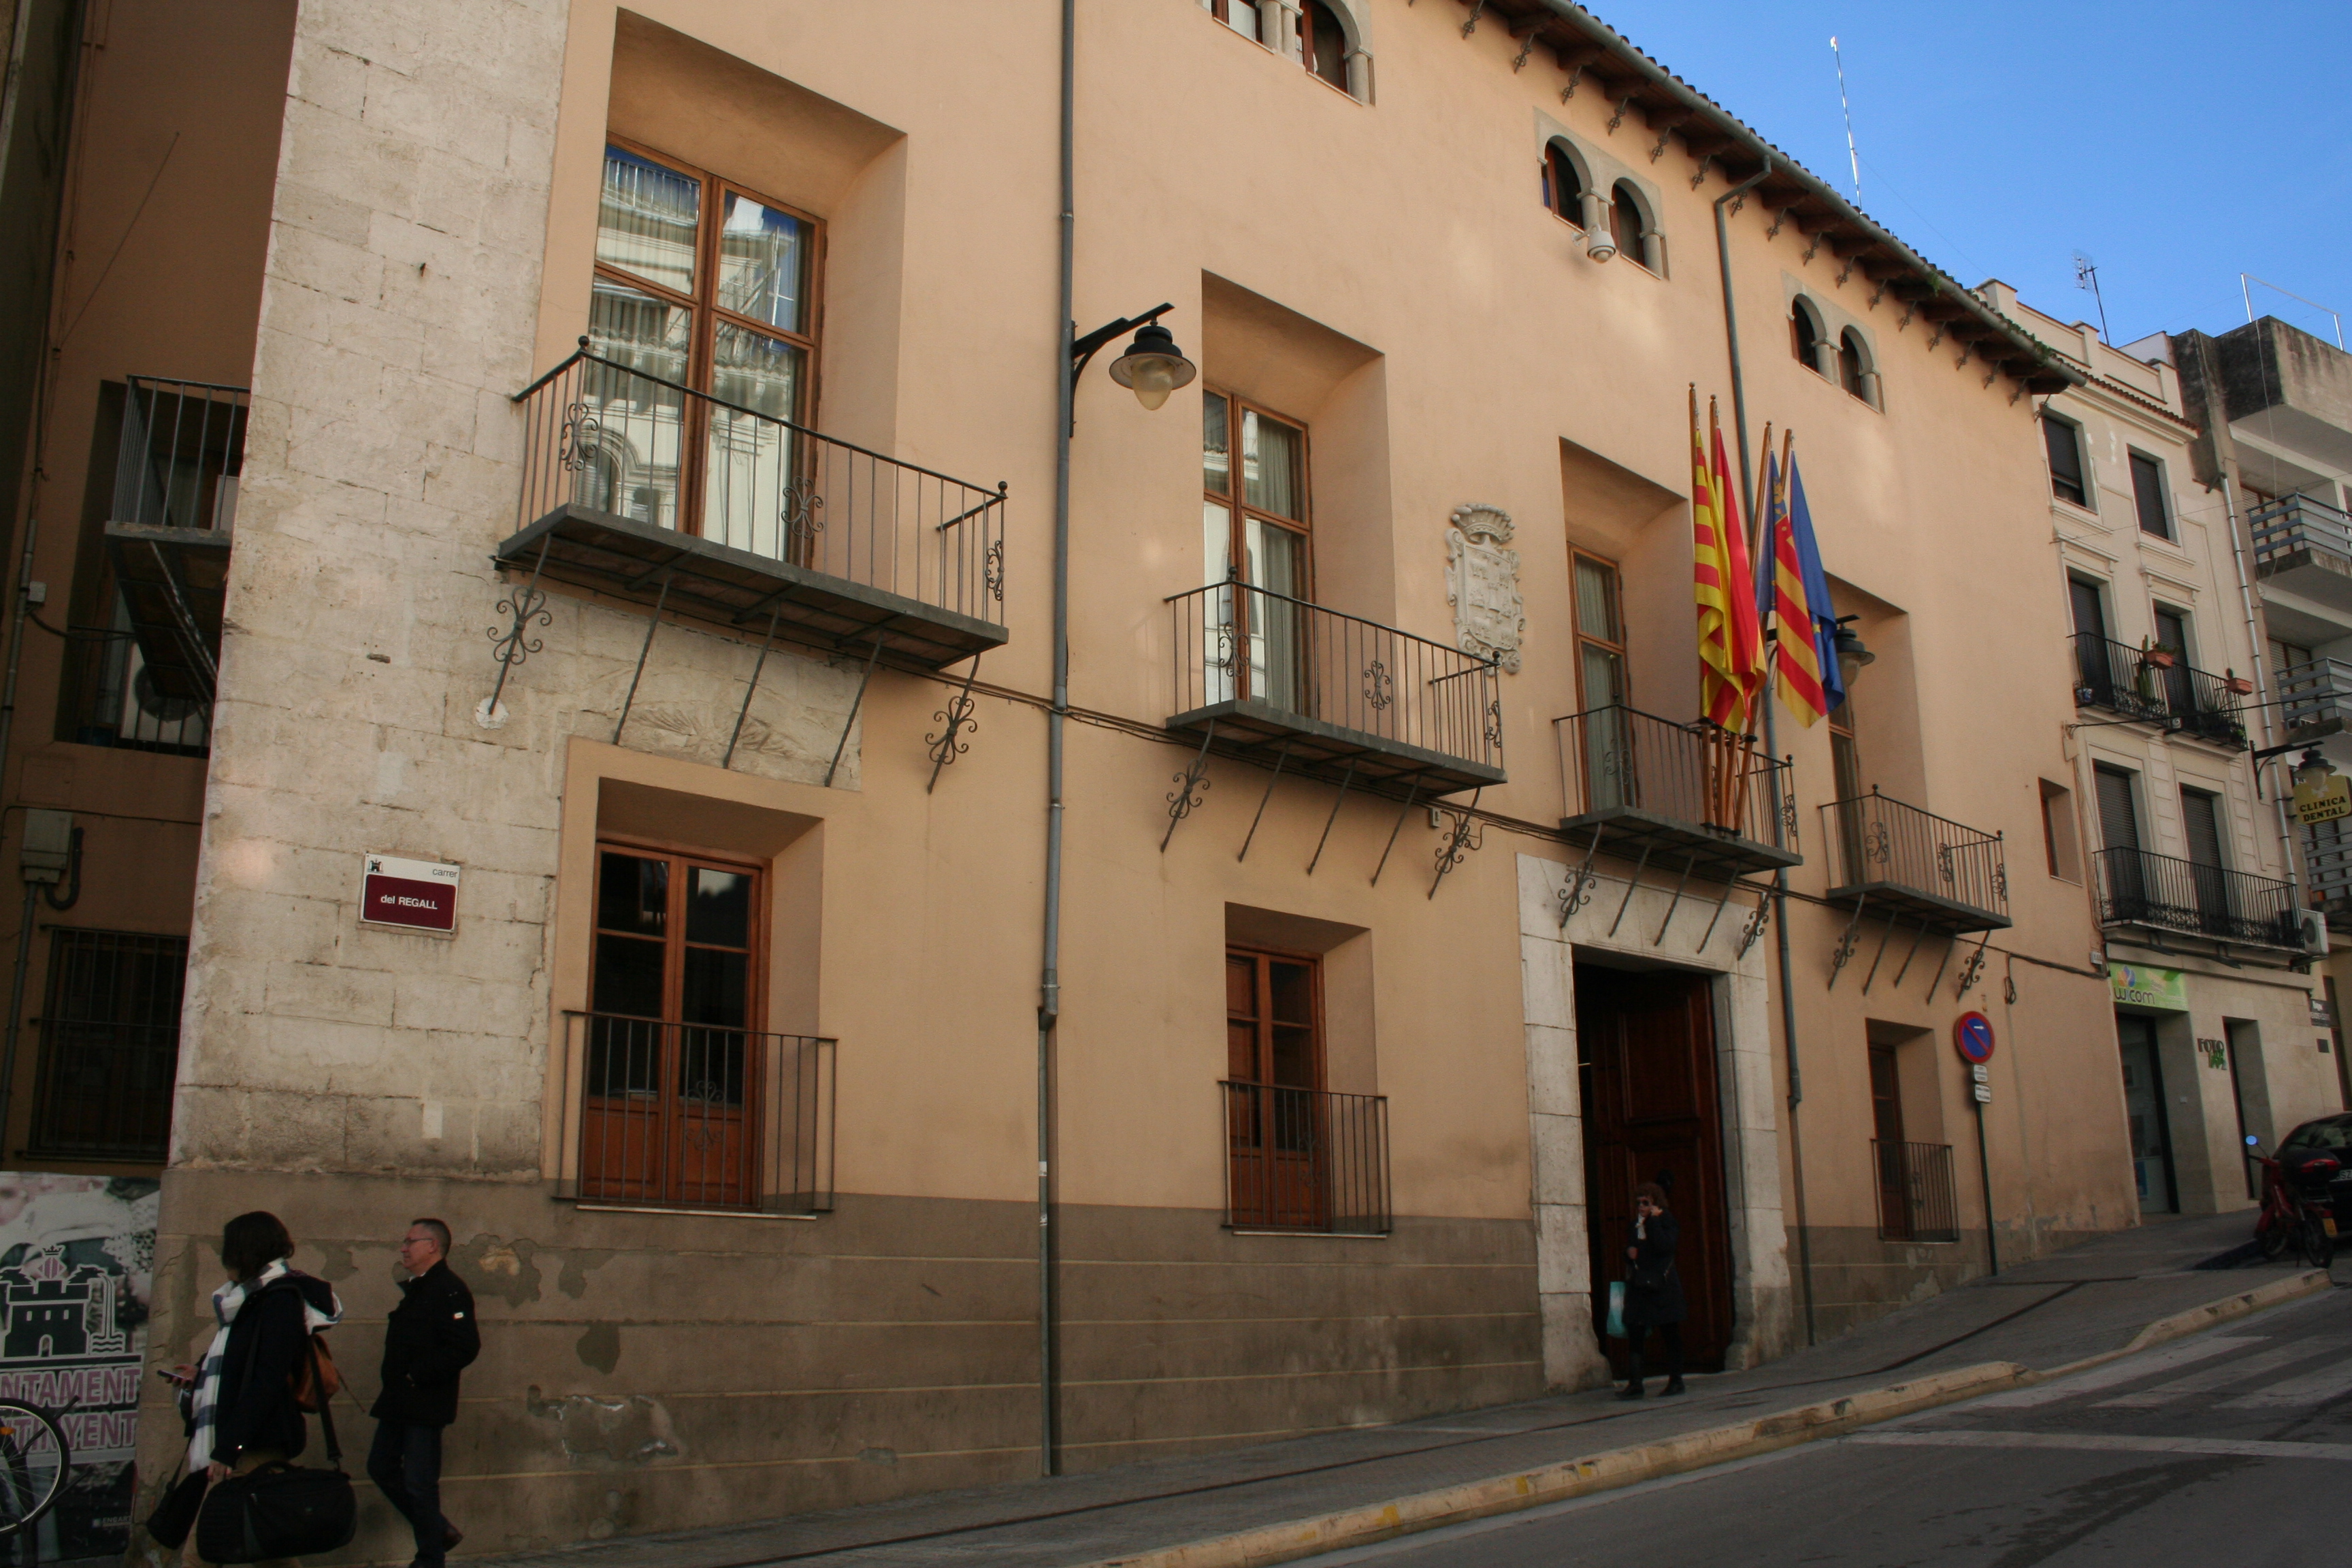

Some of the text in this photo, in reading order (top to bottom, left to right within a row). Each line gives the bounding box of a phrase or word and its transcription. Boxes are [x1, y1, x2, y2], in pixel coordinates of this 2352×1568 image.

[2300, 796, 2346, 812] CLINICA
[2303, 806, 2345, 821] DENTAL
[432, 868, 457, 878] carrer
[380, 895, 438, 909] del REGALL
[2197, 1038, 2225, 1054] FOTO
